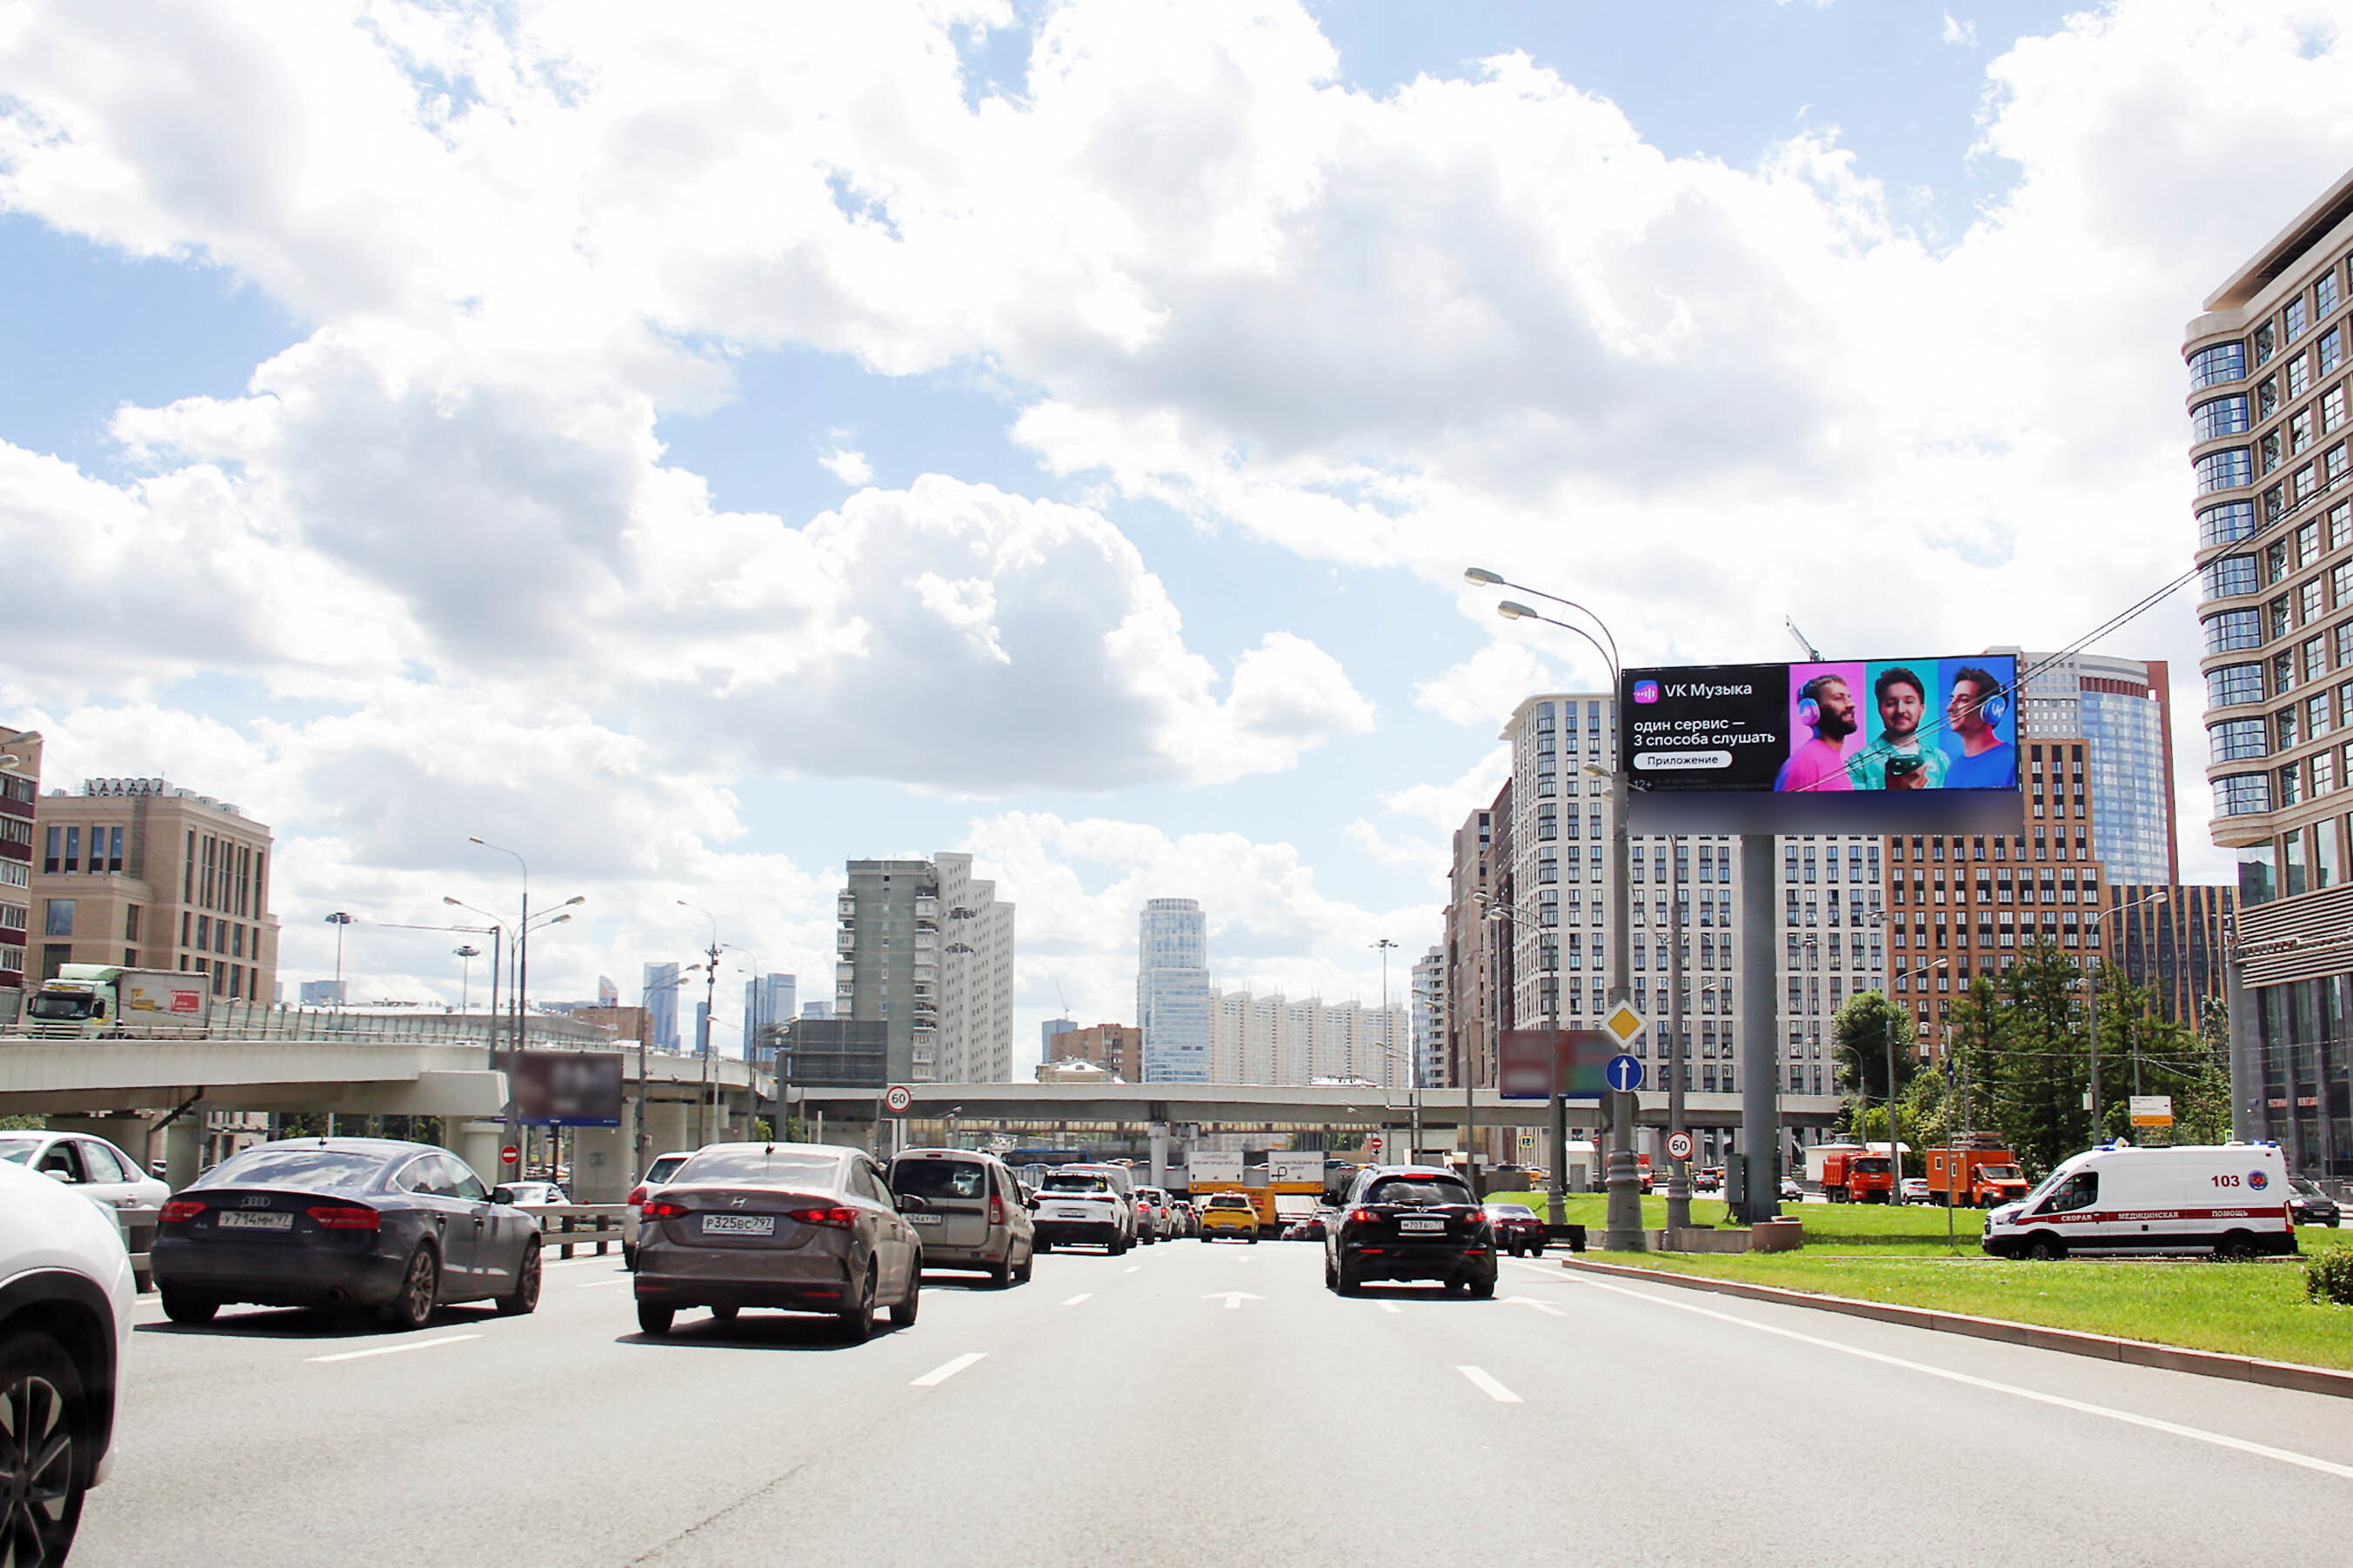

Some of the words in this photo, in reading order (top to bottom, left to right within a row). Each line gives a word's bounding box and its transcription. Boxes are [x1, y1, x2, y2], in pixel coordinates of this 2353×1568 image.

[1665, 684, 1688, 697] VK
[1691, 683, 1753, 699] Музыка
[1634, 721, 1671, 733] один
[1675, 719, 1729, 732] сервис
[1634, 735, 1643, 746] 3
[1646, 733, 1708, 746] способа
[1712, 733, 1776, 747] слушать
[1648, 756, 1719, 767] Приложение
[892, 1093, 906, 1104] 60
[1672, 1139, 1688, 1151] 60
[2211, 1175, 2240, 1187] 103
[2118, 1211, 2179, 1220] МЕДИЦИНСКАЯ
